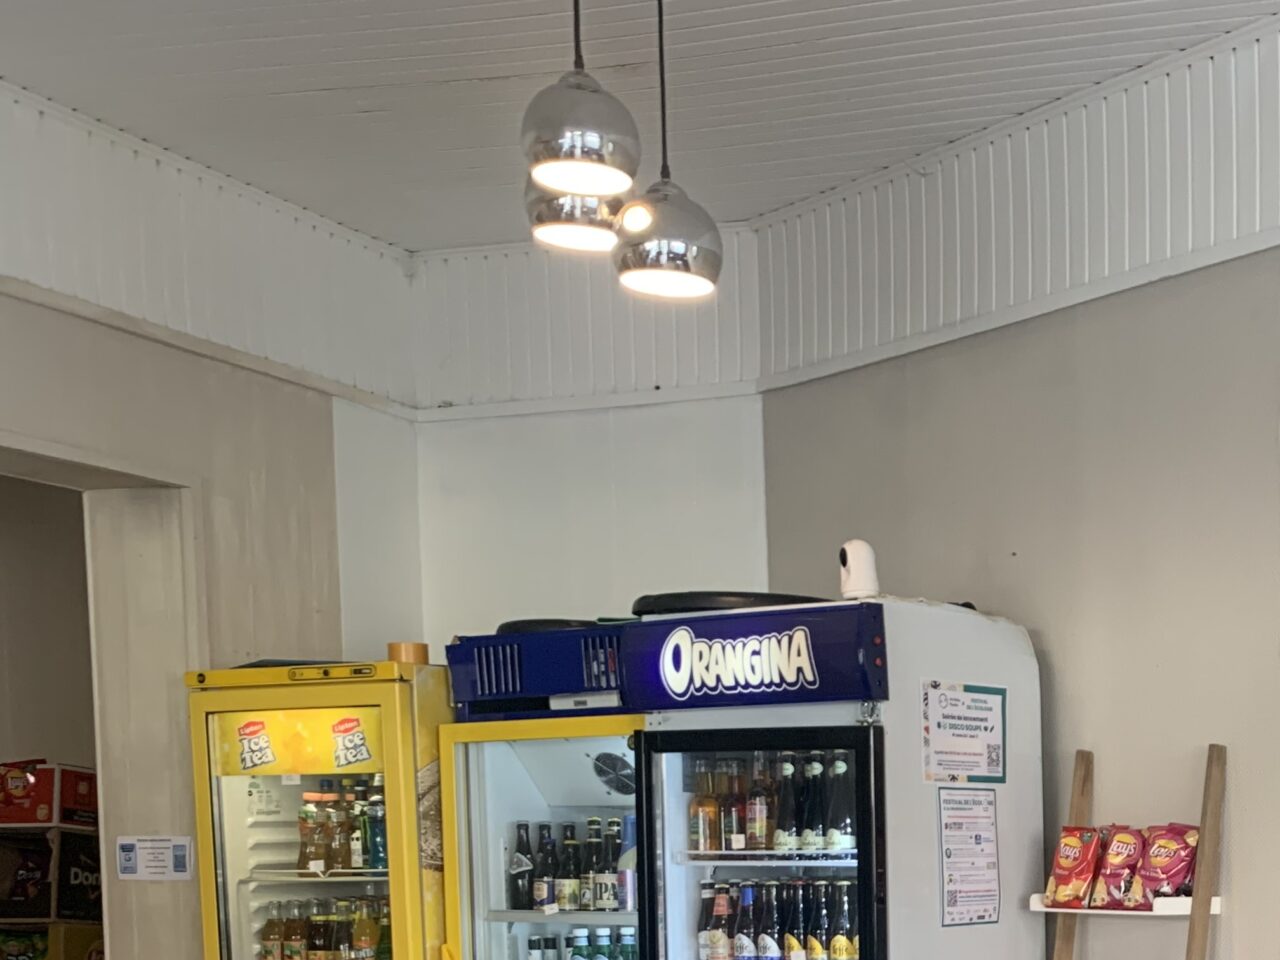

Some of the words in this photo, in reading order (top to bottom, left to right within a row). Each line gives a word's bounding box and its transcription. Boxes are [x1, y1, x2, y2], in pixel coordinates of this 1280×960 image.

[240, 734, 270, 751] Ice
[336, 731, 365, 749] Ice
[242, 749, 275, 769] Tea
[337, 746, 371, 767] Tea
